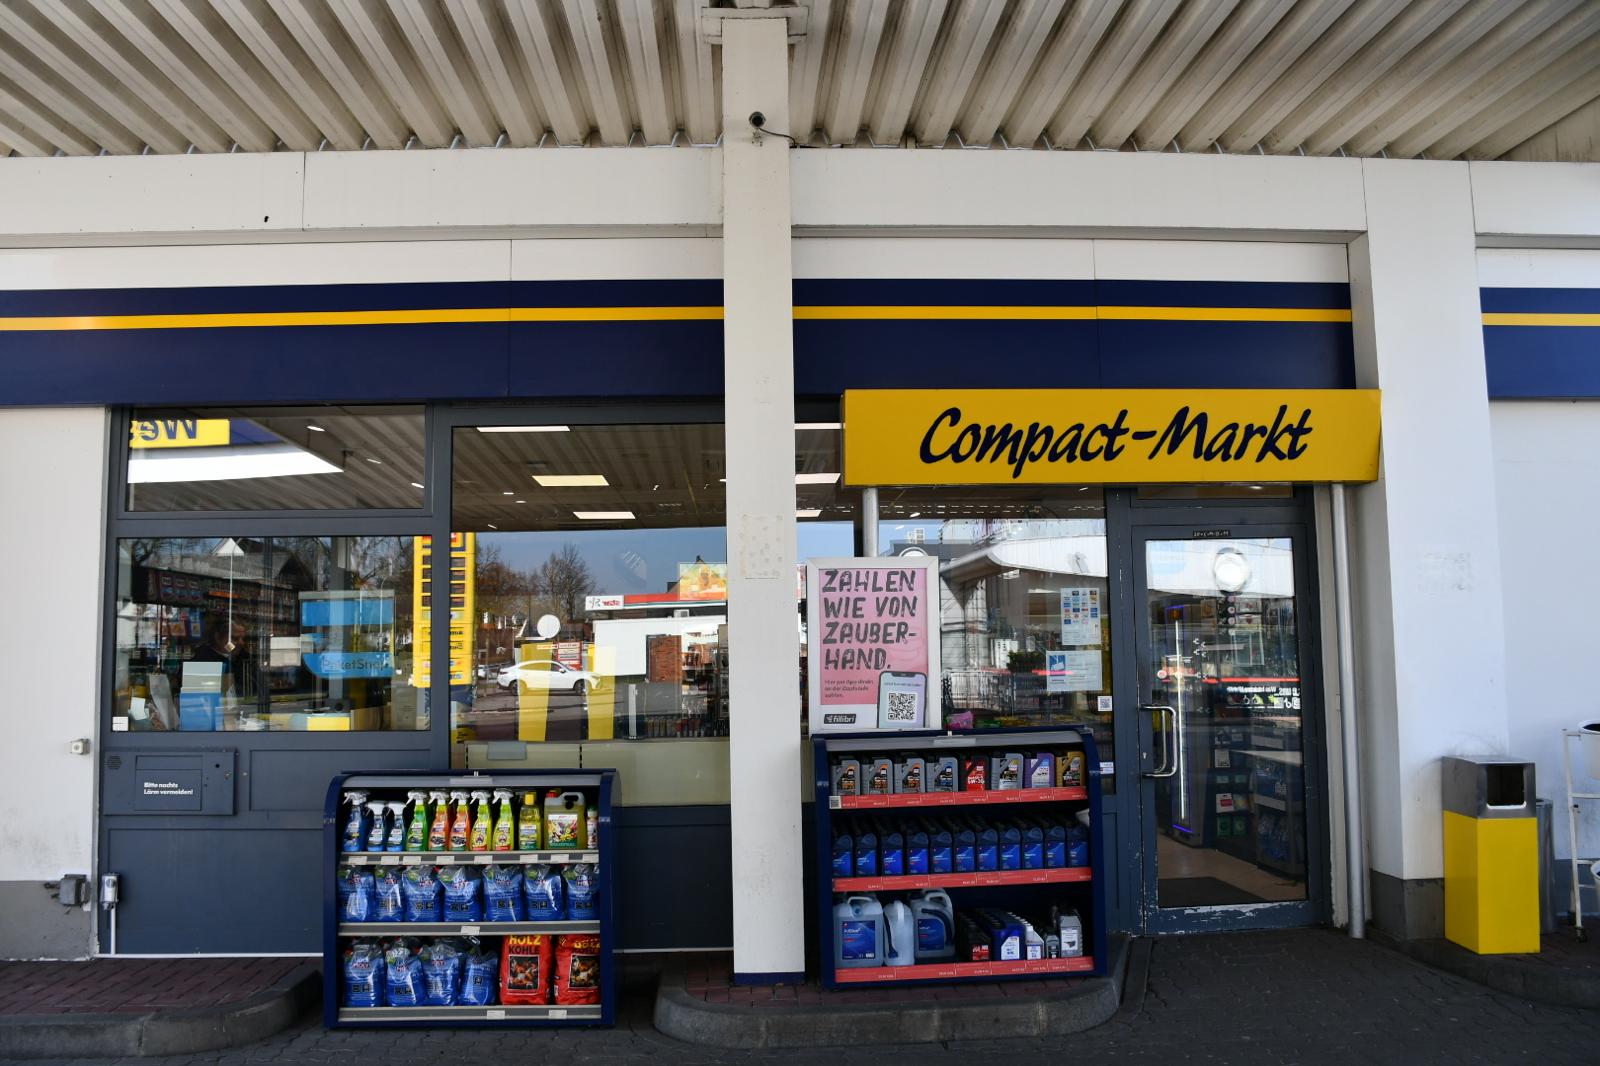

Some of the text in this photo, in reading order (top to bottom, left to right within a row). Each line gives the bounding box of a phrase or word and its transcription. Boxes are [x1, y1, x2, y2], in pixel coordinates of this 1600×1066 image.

[919, 404, 1312, 479] Compact-Markt
[822, 569, 917, 593] ZAHLEN
[823, 595, 918, 618] WIE VON
[822, 621, 917, 645] ZAUBER-
[823, 647, 892, 670] HAND.
